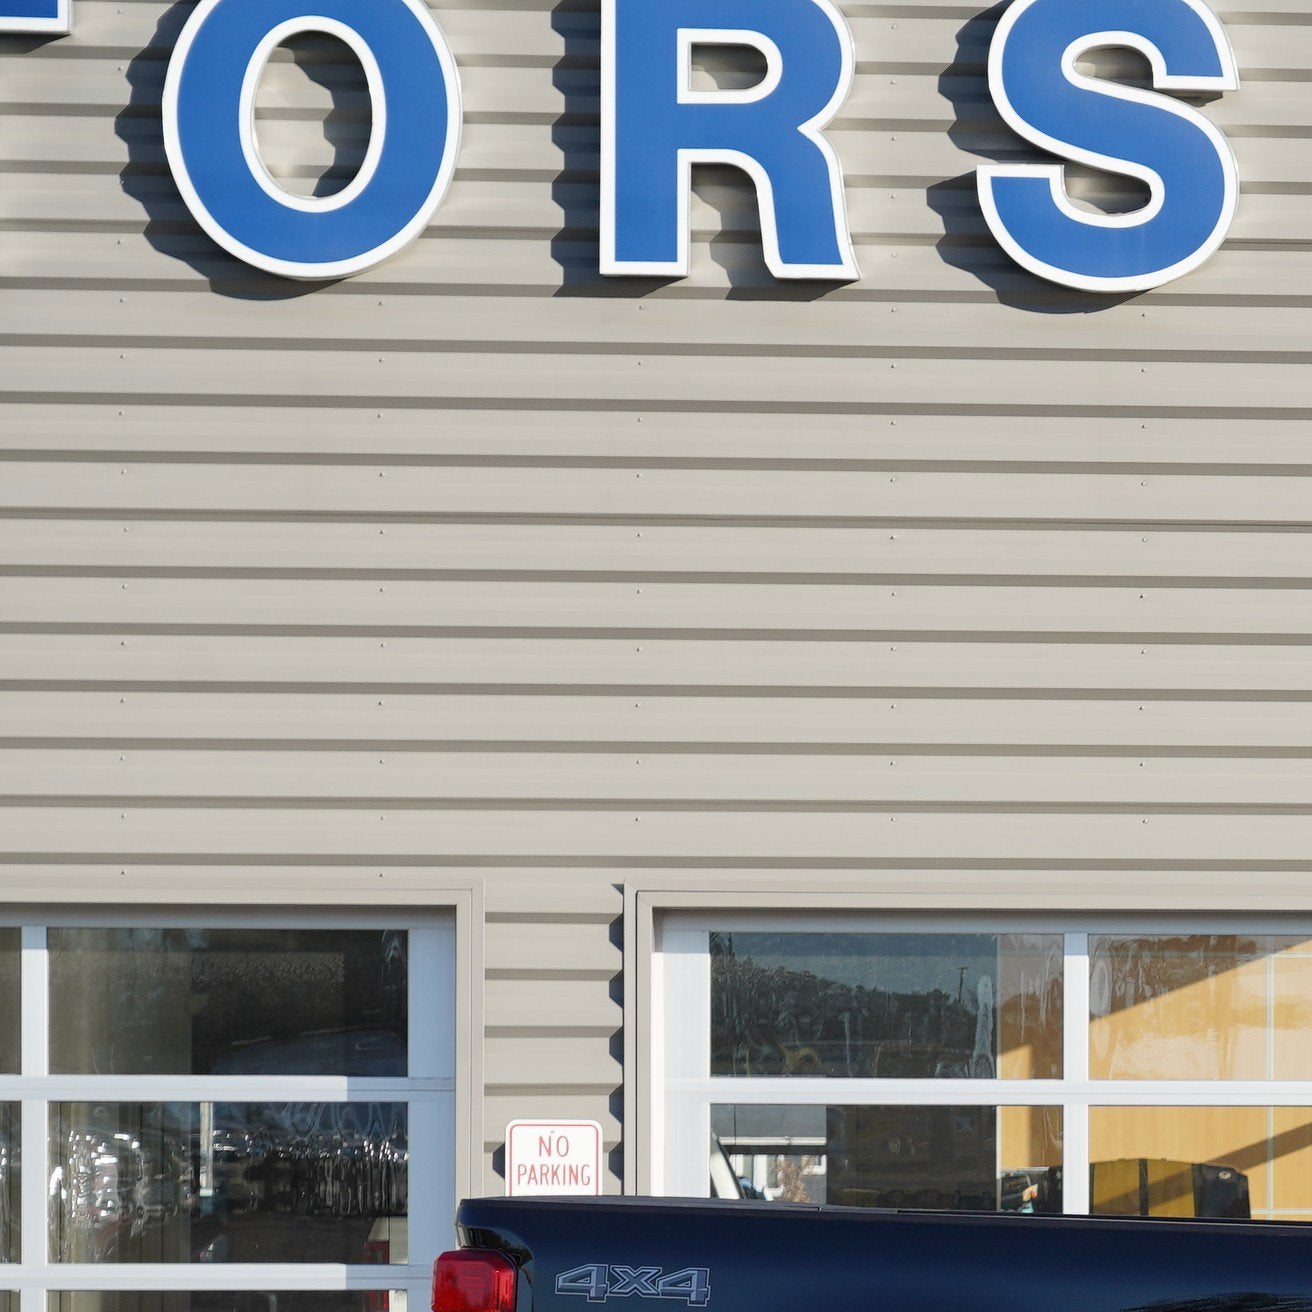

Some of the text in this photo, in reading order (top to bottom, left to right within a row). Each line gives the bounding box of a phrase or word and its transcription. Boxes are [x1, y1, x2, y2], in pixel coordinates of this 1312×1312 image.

[0, 0, 1240, 294] ORS
[538, 1135, 570, 1158] NO
[517, 1163, 591, 1186] PARKING
